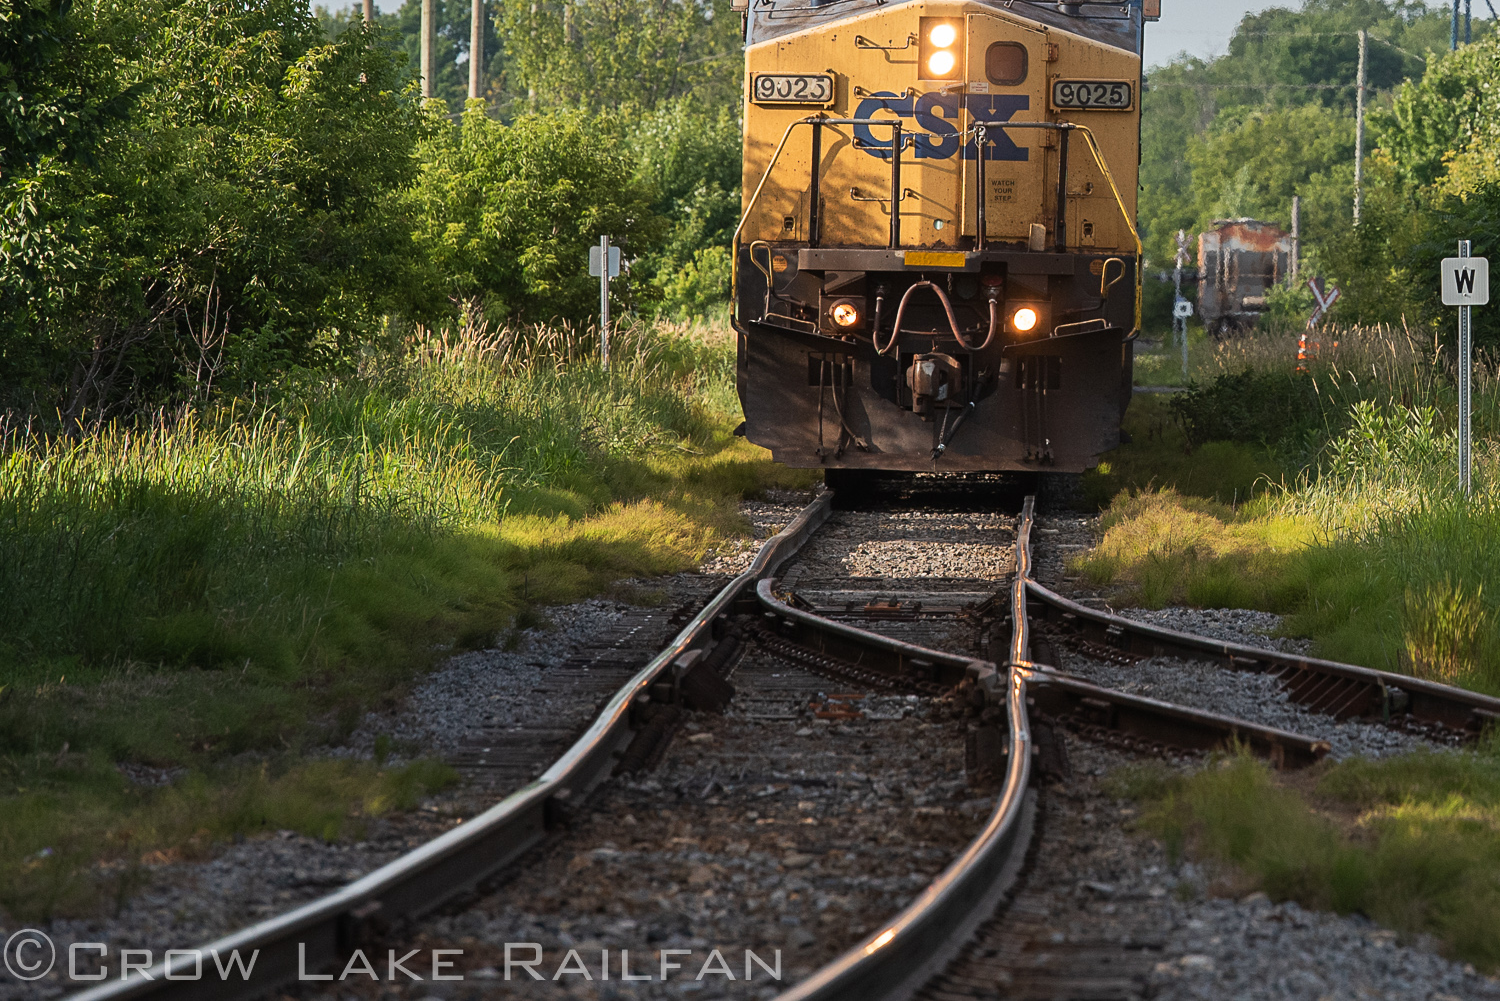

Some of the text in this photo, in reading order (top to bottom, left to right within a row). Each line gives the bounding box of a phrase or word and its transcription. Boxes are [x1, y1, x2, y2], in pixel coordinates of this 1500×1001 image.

[760, 77, 826, 99] 9025
[1060, 84, 1124, 105] 9025
[853, 91, 1030, 161] CSX
[1454, 269, 1476, 294] W
